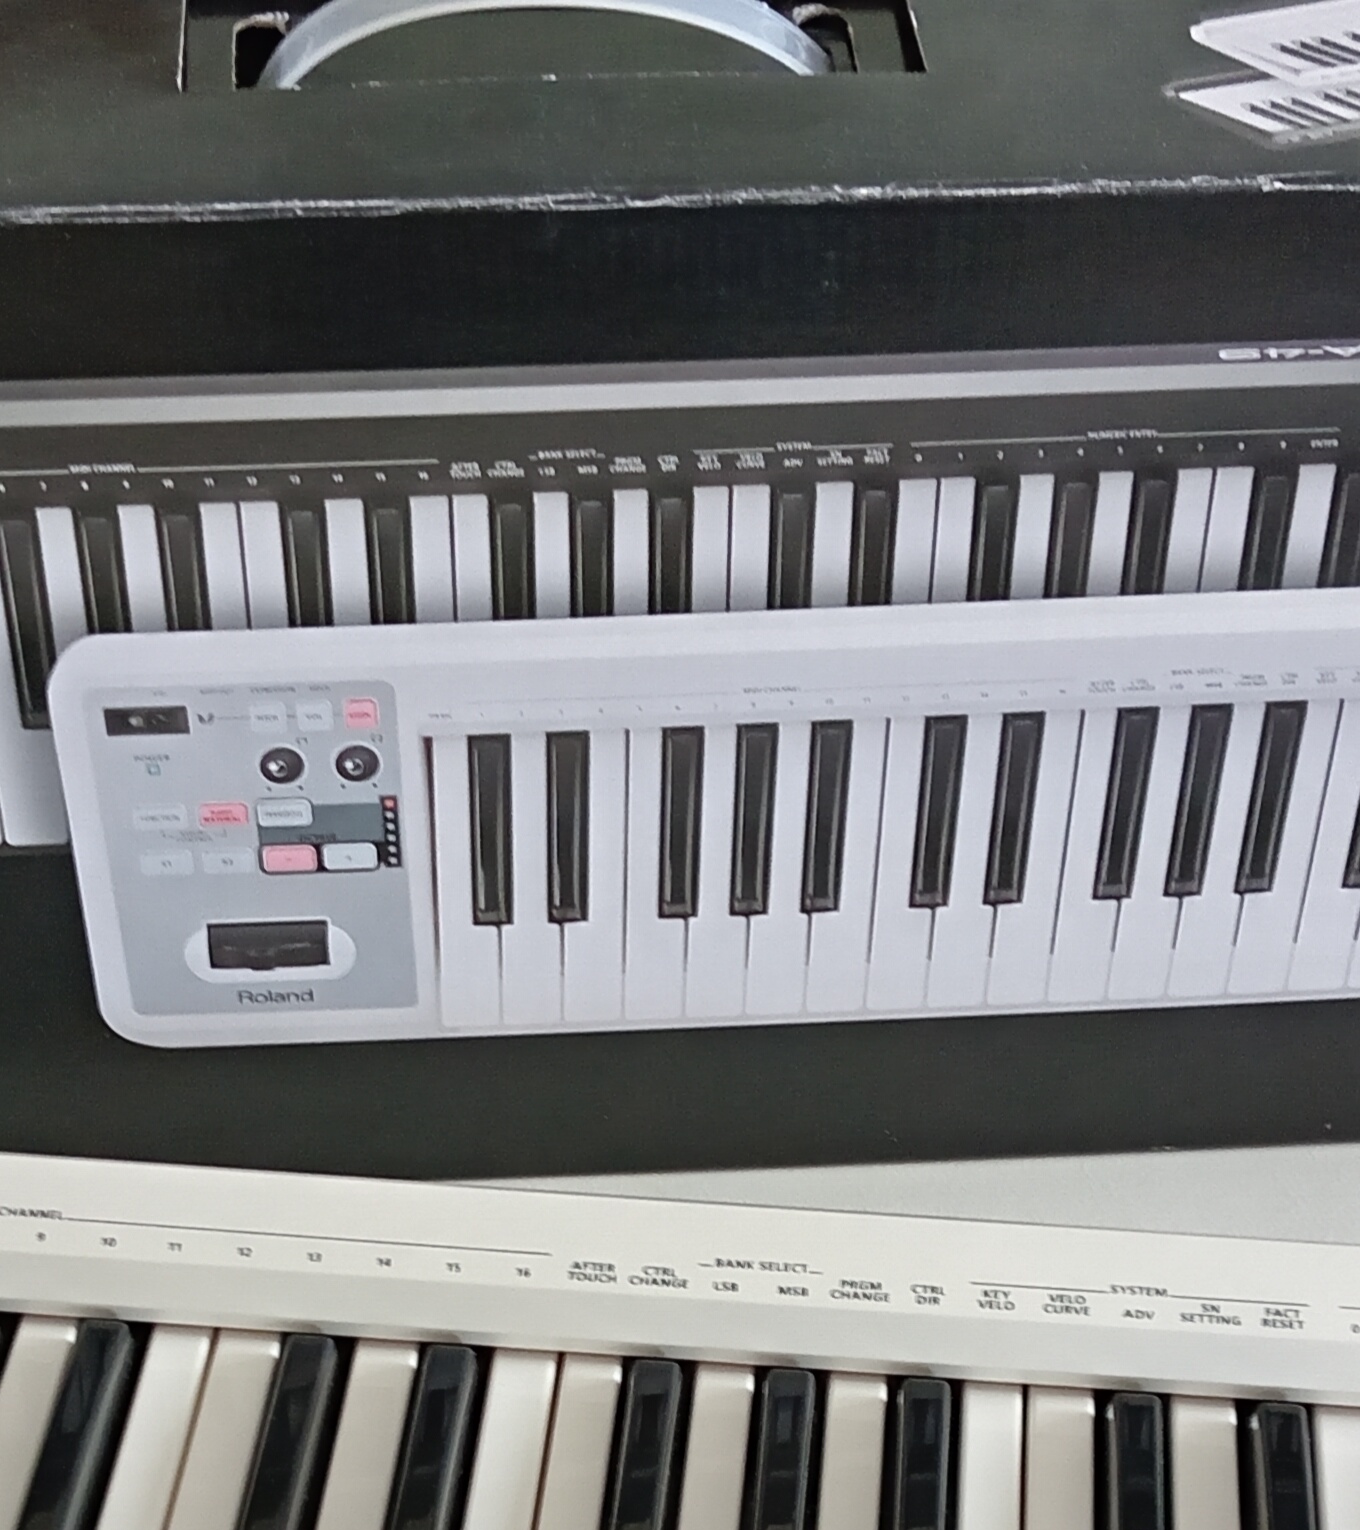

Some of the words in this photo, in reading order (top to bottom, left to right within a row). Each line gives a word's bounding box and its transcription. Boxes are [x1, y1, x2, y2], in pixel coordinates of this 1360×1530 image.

[236, 987, 316, 1006] Roland
[102, 1238, 117, 1247] 10
[237, 1247, 252, 1257] 12
[446, 1263, 461, 1272] 15
[571, 1262, 615, 1272] AFTER
[715, 1258, 753, 1269] BANK
[759, 1261, 807, 1273] SELECT
[568, 1271, 617, 1283] TOUCH
[642, 1266, 677, 1277] CTRL
[629, 1273, 688, 1288] CHANGE
[841, 1280, 882, 1290] PRGM
[714, 1282, 738, 1292] LSB
[778, 1286, 808, 1296] MSB
[910, 1284, 946, 1296] CTRL
[1110, 1285, 1171, 1297] SYSTEM
[830, 1289, 889, 1302] CHANGE
[912, 1291, 940, 1305] DIR
[982, 1290, 1010, 1299] KEY
[1048, 1294, 1086, 1305] VELO
[977, 1300, 1015, 1311] VELO
[1043, 1304, 1089, 1316] CURVE
[1201, 1304, 1220, 1313] SN
[1123, 1310, 1154, 1319] ADV
[1265, 1308, 1300, 1318] FACT
[1180, 1313, 1242, 1326] SETTING
[1261, 1318, 1304, 1329] RESET
